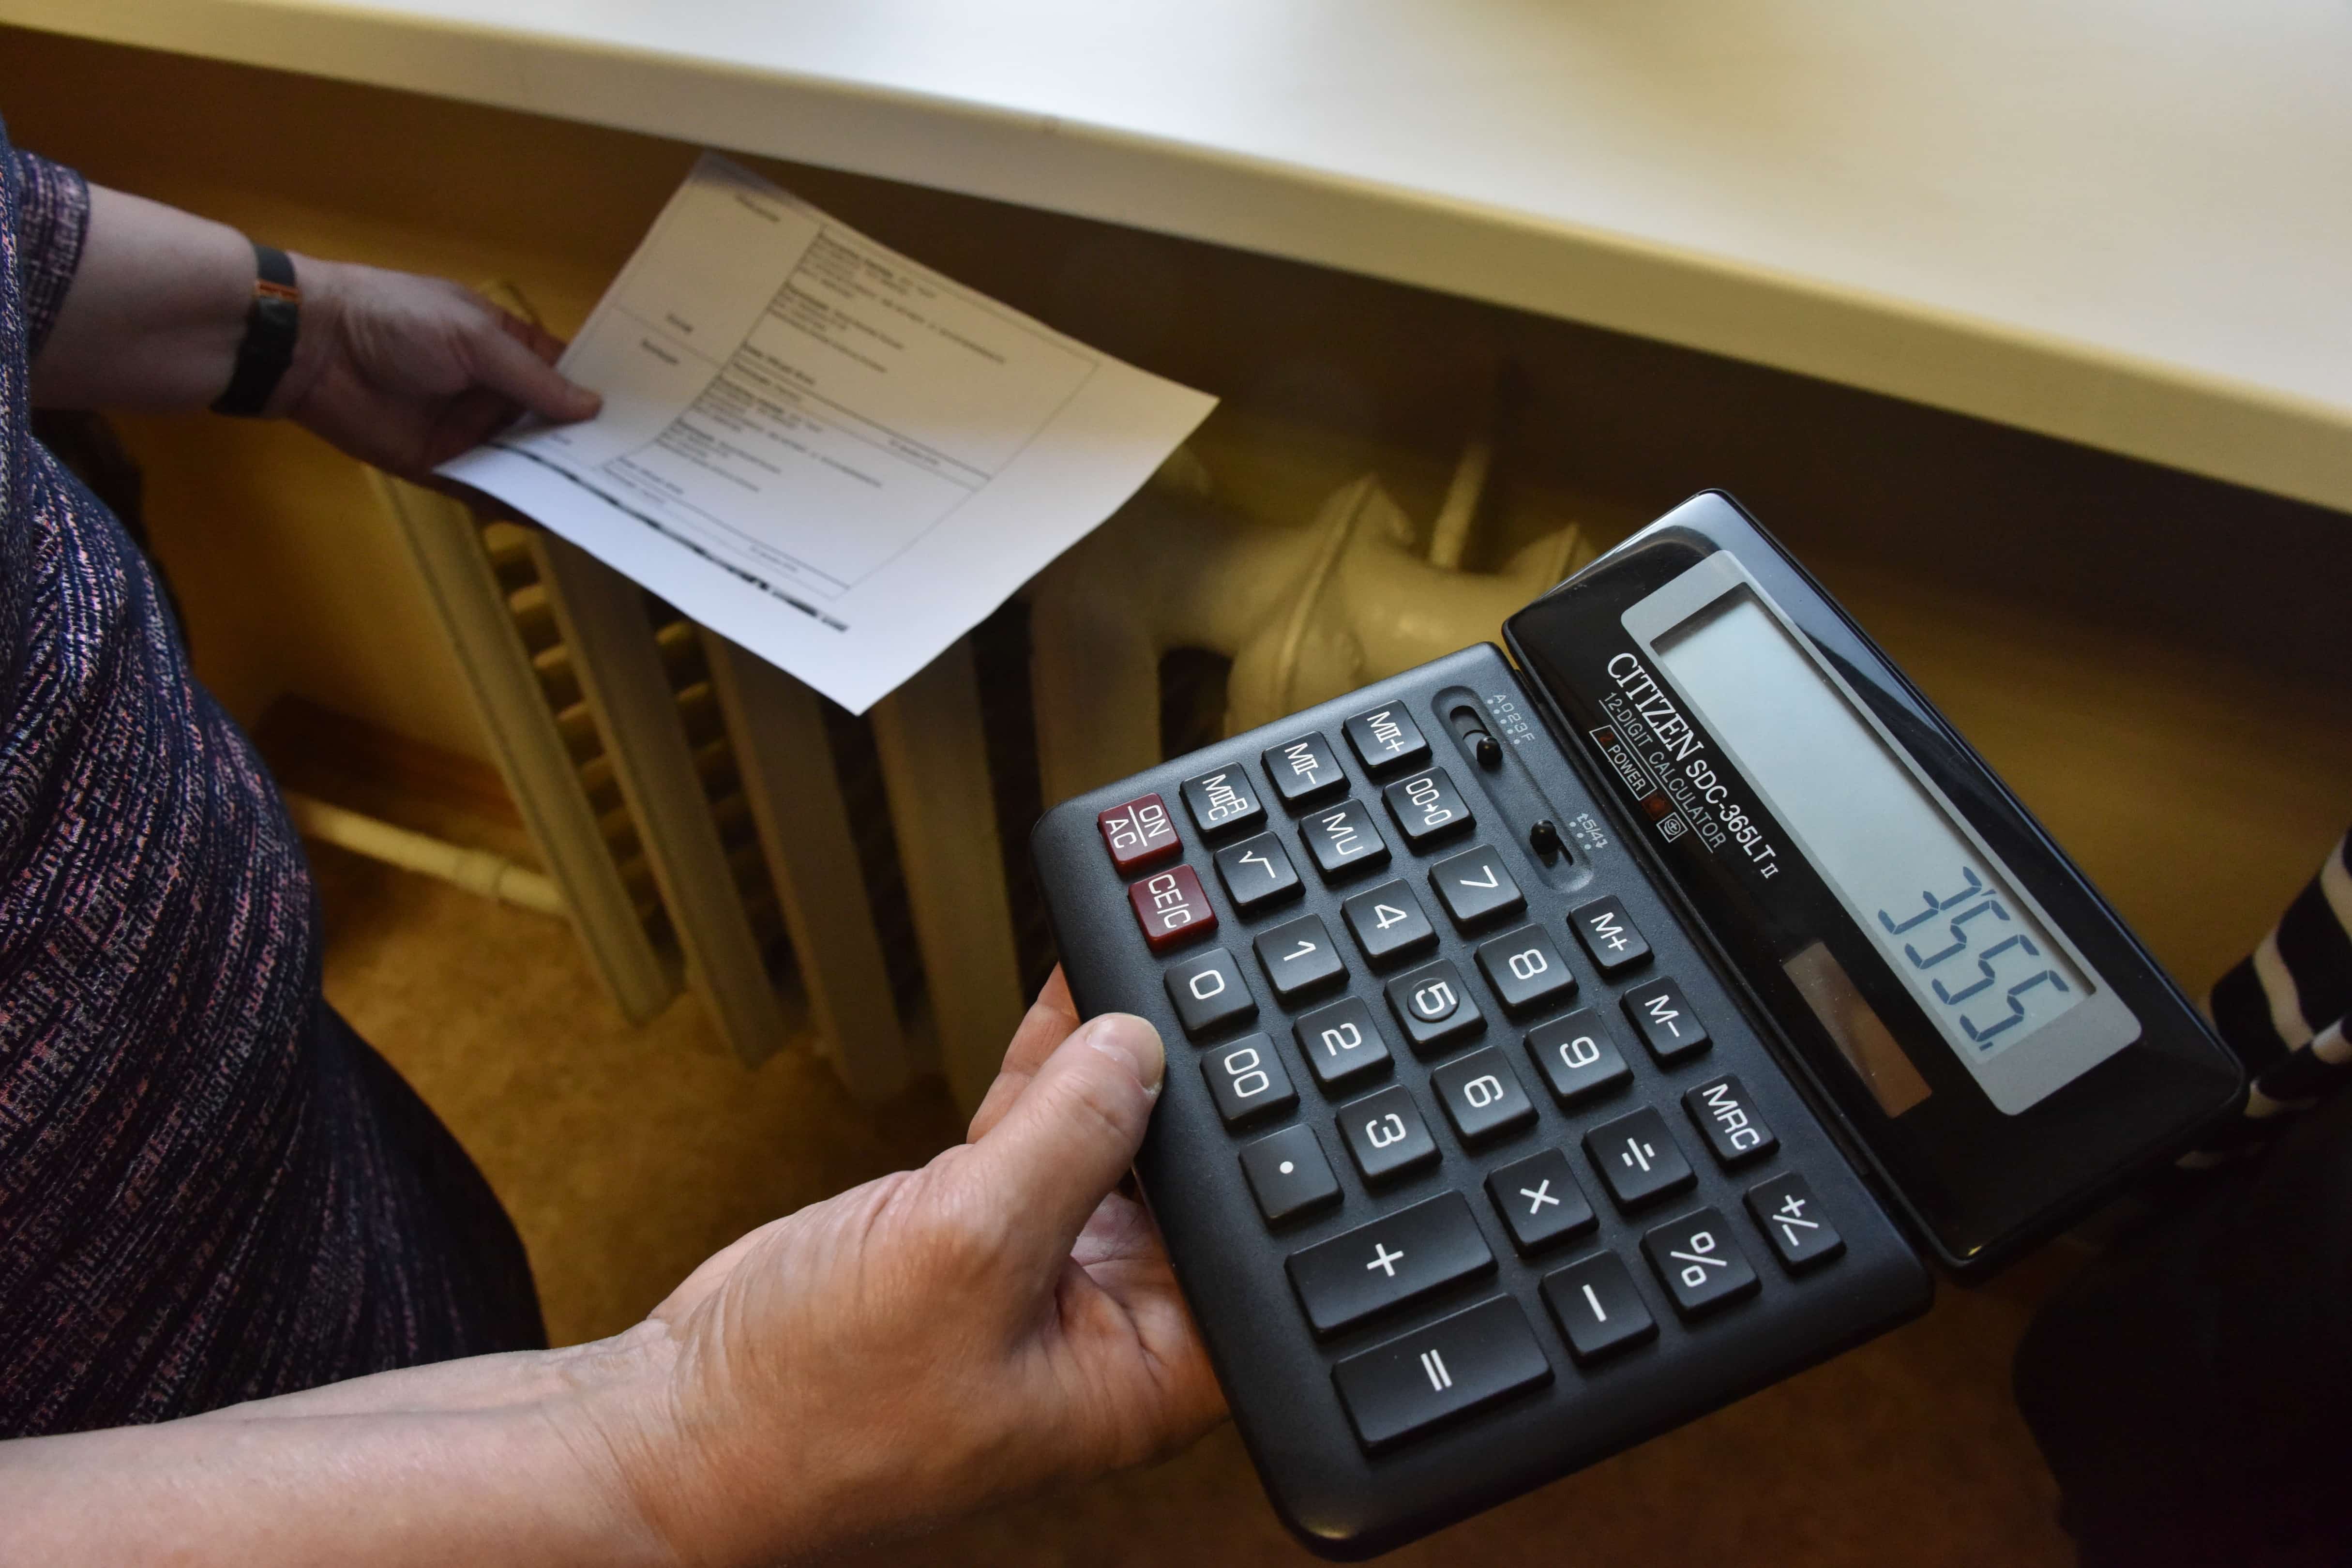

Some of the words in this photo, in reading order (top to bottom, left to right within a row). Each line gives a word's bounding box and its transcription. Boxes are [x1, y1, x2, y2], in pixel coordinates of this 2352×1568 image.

[1607, 653, 1704, 761] CITIZEN
[1605, 693, 1653, 746] 12-DIGIT
[1649, 752, 1726, 847] CALCULATOR
[1608, 744, 1645, 791] POWER
[1106, 819, 1137, 849] AC
[1139, 804, 1169, 838] ON
[1322, 812, 1363, 856] MU
[1460, 865, 1498, 888] 7
[1374, 905, 1407, 929] 4
[1591, 913, 1627, 950] M+
[1283, 941, 1316, 961] 1
[1509, 950, 1547, 980] 8
[1190, 970, 1225, 999] 0
[1415, 982, 1456, 1015] 5
[1645, 995, 1679, 1037] M-
[1322, 1023, 1361, 1056] 2
[1560, 1037, 1599, 1068] 9
[1224, 1048, 1269, 1097] 00
[1464, 1076, 1503, 1107] 6
[1366, 1114, 1406, 1147] 3
[1703, 1084, 1760, 1149] MRC
[1671, 1232, 1726, 1286] %
